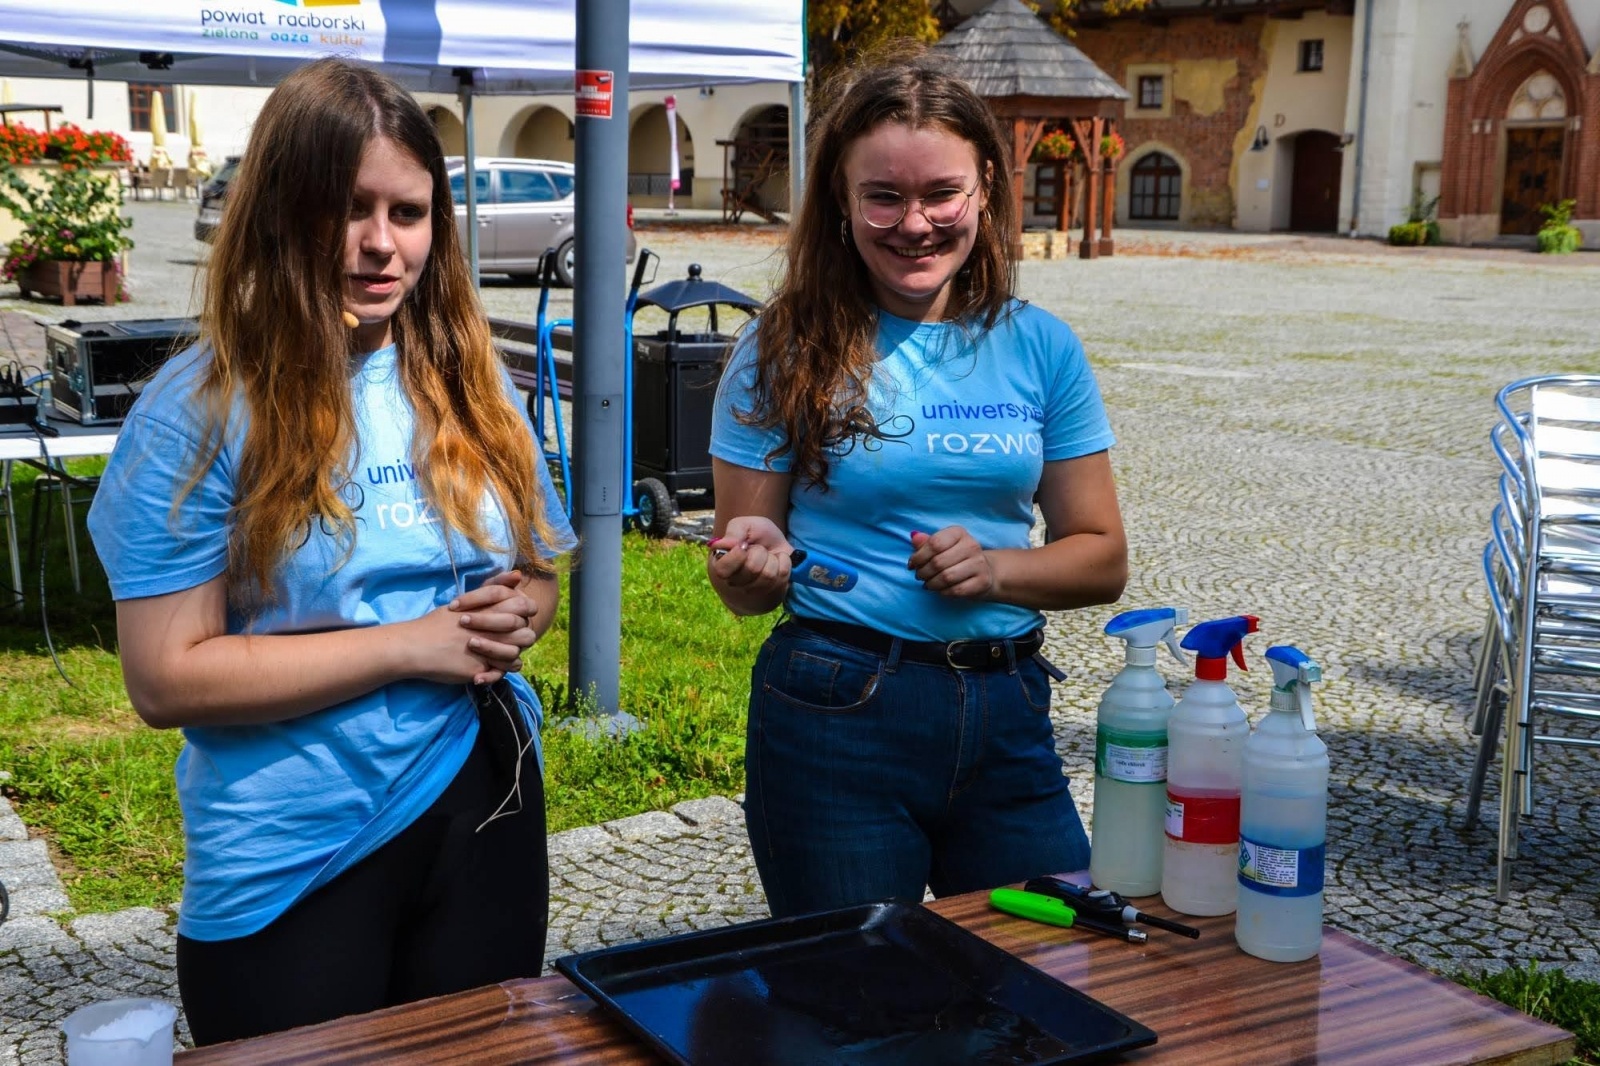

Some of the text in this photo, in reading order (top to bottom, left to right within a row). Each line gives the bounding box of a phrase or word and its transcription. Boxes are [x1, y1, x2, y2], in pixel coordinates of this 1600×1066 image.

[201, 8, 365, 31] powiat raciborski
[202, 27, 365, 46] zielona oaza kultur
